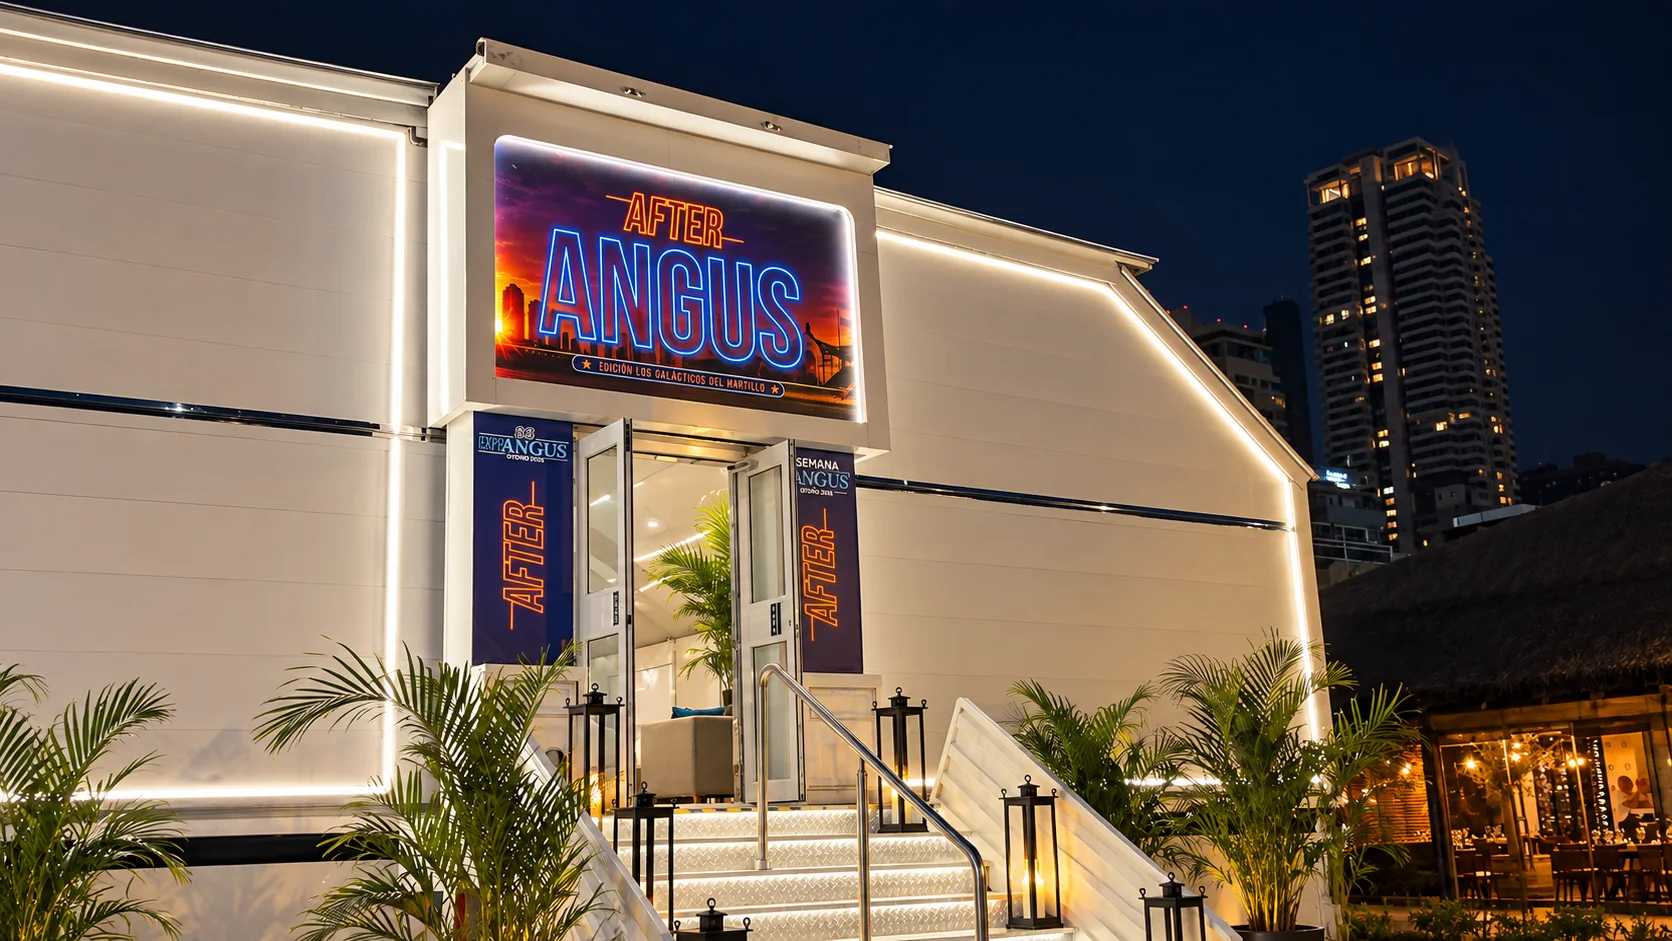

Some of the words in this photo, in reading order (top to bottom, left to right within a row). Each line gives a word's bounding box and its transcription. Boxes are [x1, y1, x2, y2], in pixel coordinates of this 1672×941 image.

[622, 191, 724, 249] AFTER
[538, 227, 803, 368] ANGUS
[635, 366, 652, 378] LOS
[726, 378, 765, 393] MARTILLO
[796, 457, 839, 470] SEMANA
[502, 499, 545, 614] AFTER
[801, 524, 839, 628] AFTER
